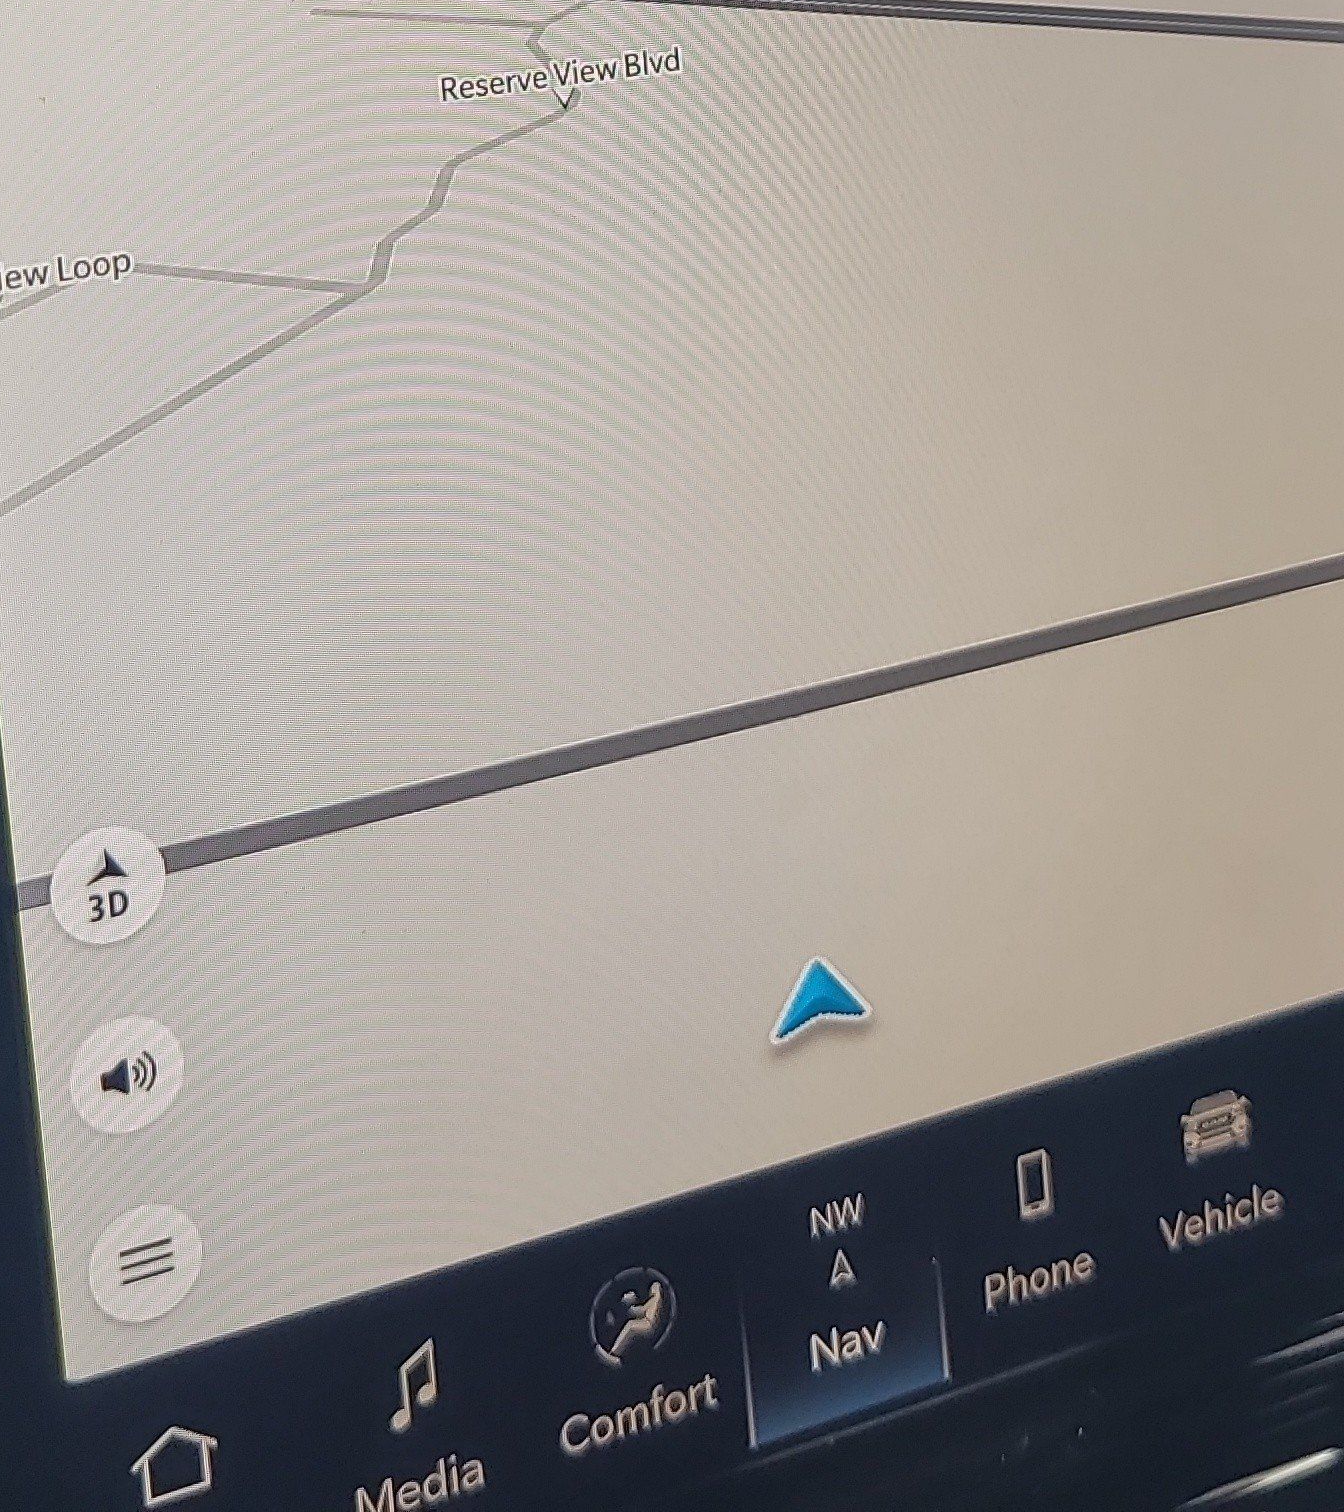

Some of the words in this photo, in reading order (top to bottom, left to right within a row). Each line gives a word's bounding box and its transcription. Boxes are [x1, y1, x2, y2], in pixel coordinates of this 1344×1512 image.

[441, 72, 549, 102] Reserve
[554, 59, 621, 88] View
[625, 47, 682, 77] Blvd
[57, 253, 131, 282] Loop
[88, 891, 129, 922] 3D
[809, 1192, 866, 1239] NW
[1159, 1183, 1284, 1252] Vehicle
[984, 1247, 1096, 1315] Phone
[809, 1320, 886, 1372] Nav
[560, 1373, 719, 1456] Comfort
[356, 1454, 487, 1512] Media
